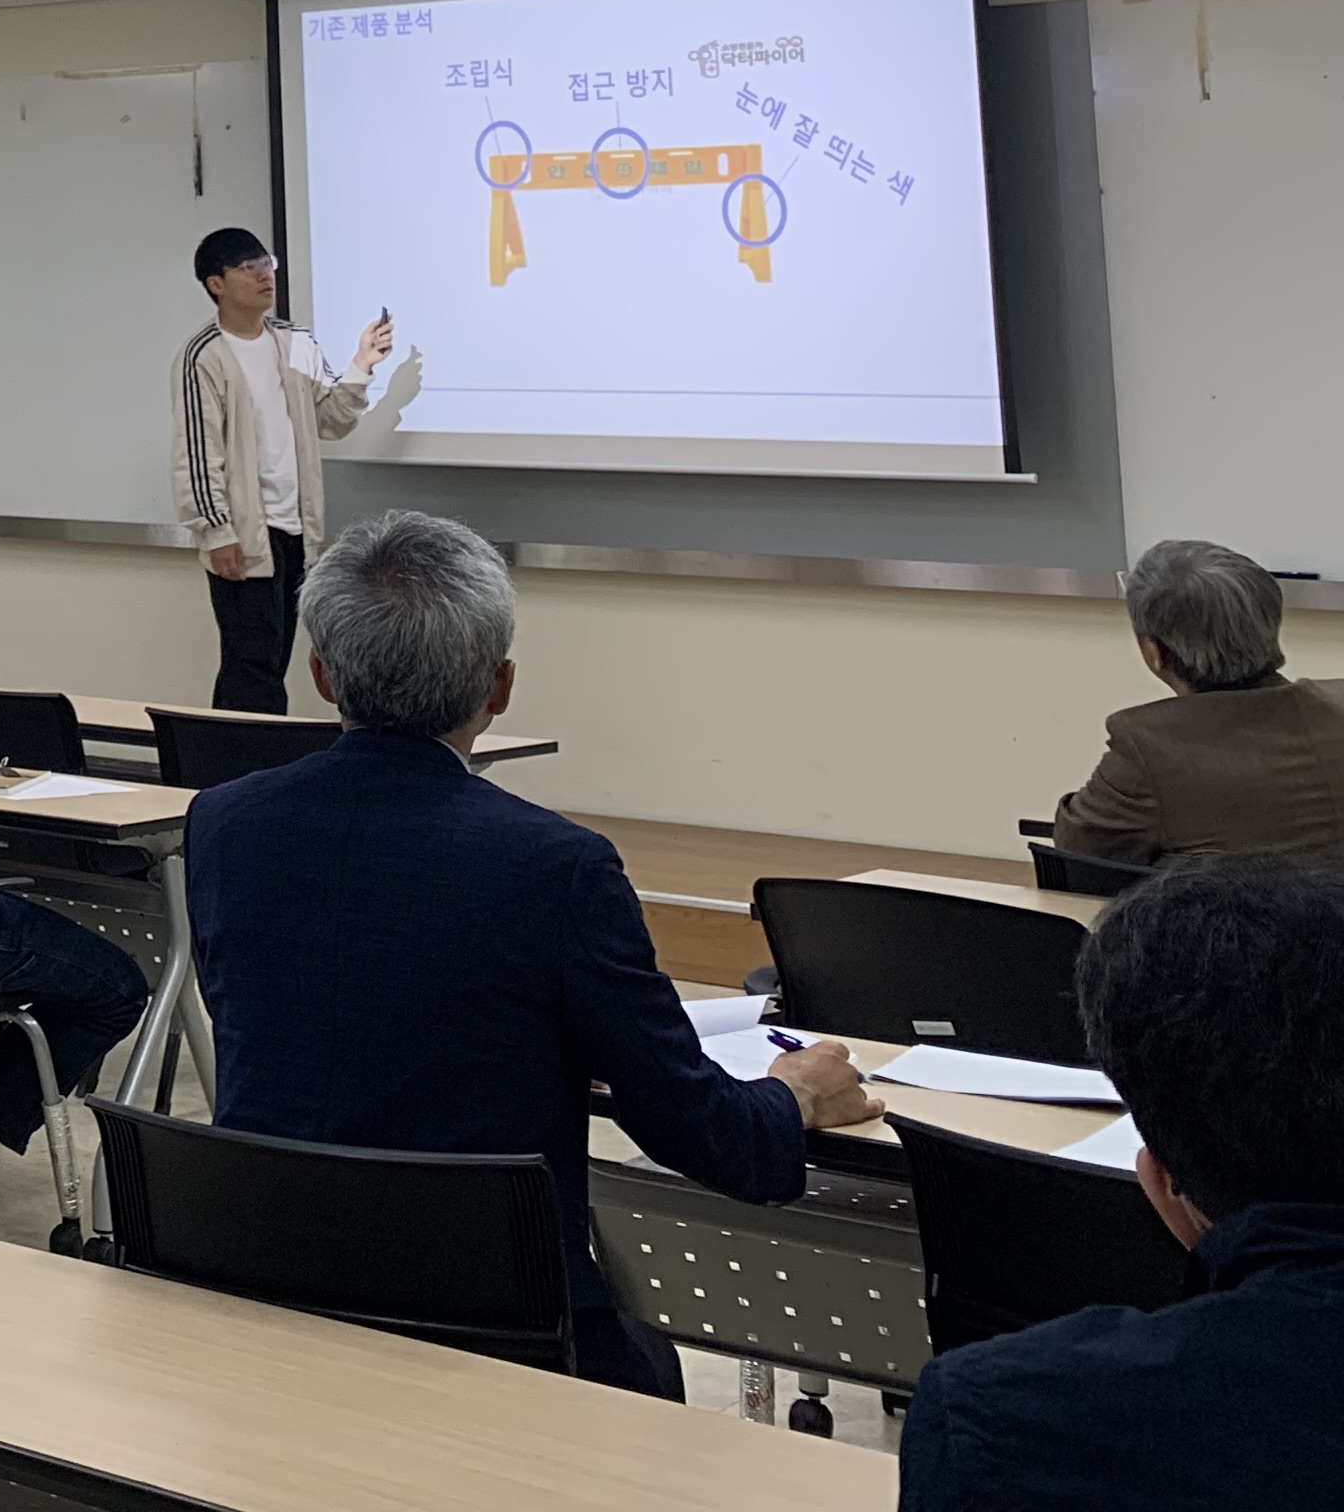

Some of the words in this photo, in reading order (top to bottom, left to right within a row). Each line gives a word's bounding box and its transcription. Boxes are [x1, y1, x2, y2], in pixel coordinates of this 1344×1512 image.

[308, 16, 347, 41] 기존
[350, 12, 390, 38] 제품
[393, 8, 434, 34] 분석
[445, 58, 514, 88] 조립식
[567, 71, 616, 102] 접근
[626, 67, 675, 98] 방지
[735, 81, 787, 130] 눈에
[792, 113, 819, 149] 잘
[823, 134, 875, 184] 띄는
[886, 170, 915, 206] 색
